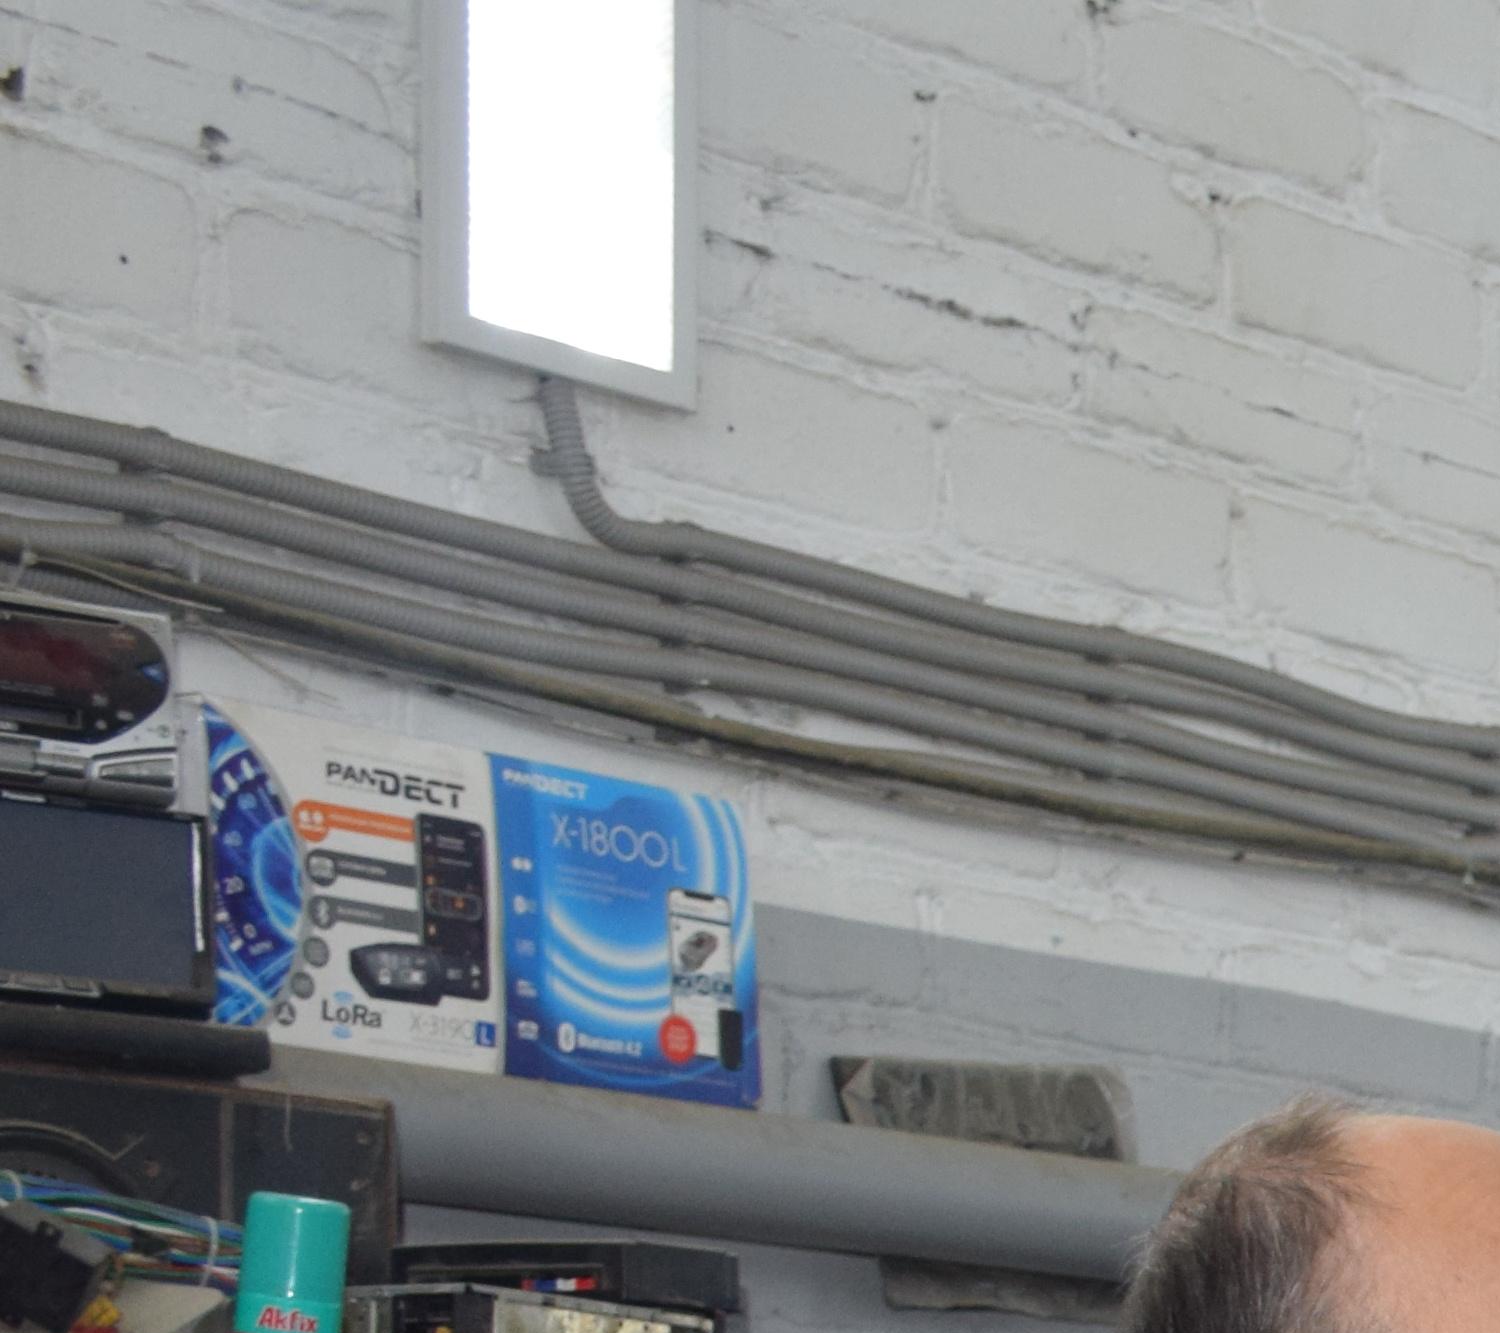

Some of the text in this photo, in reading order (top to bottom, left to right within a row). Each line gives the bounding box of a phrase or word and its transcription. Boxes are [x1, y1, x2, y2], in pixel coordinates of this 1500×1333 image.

[325, 761, 466, 808] PANDECT
[321, 1000, 382, 1028] LoRa
[257, 1307, 319, 1333] Akfix
